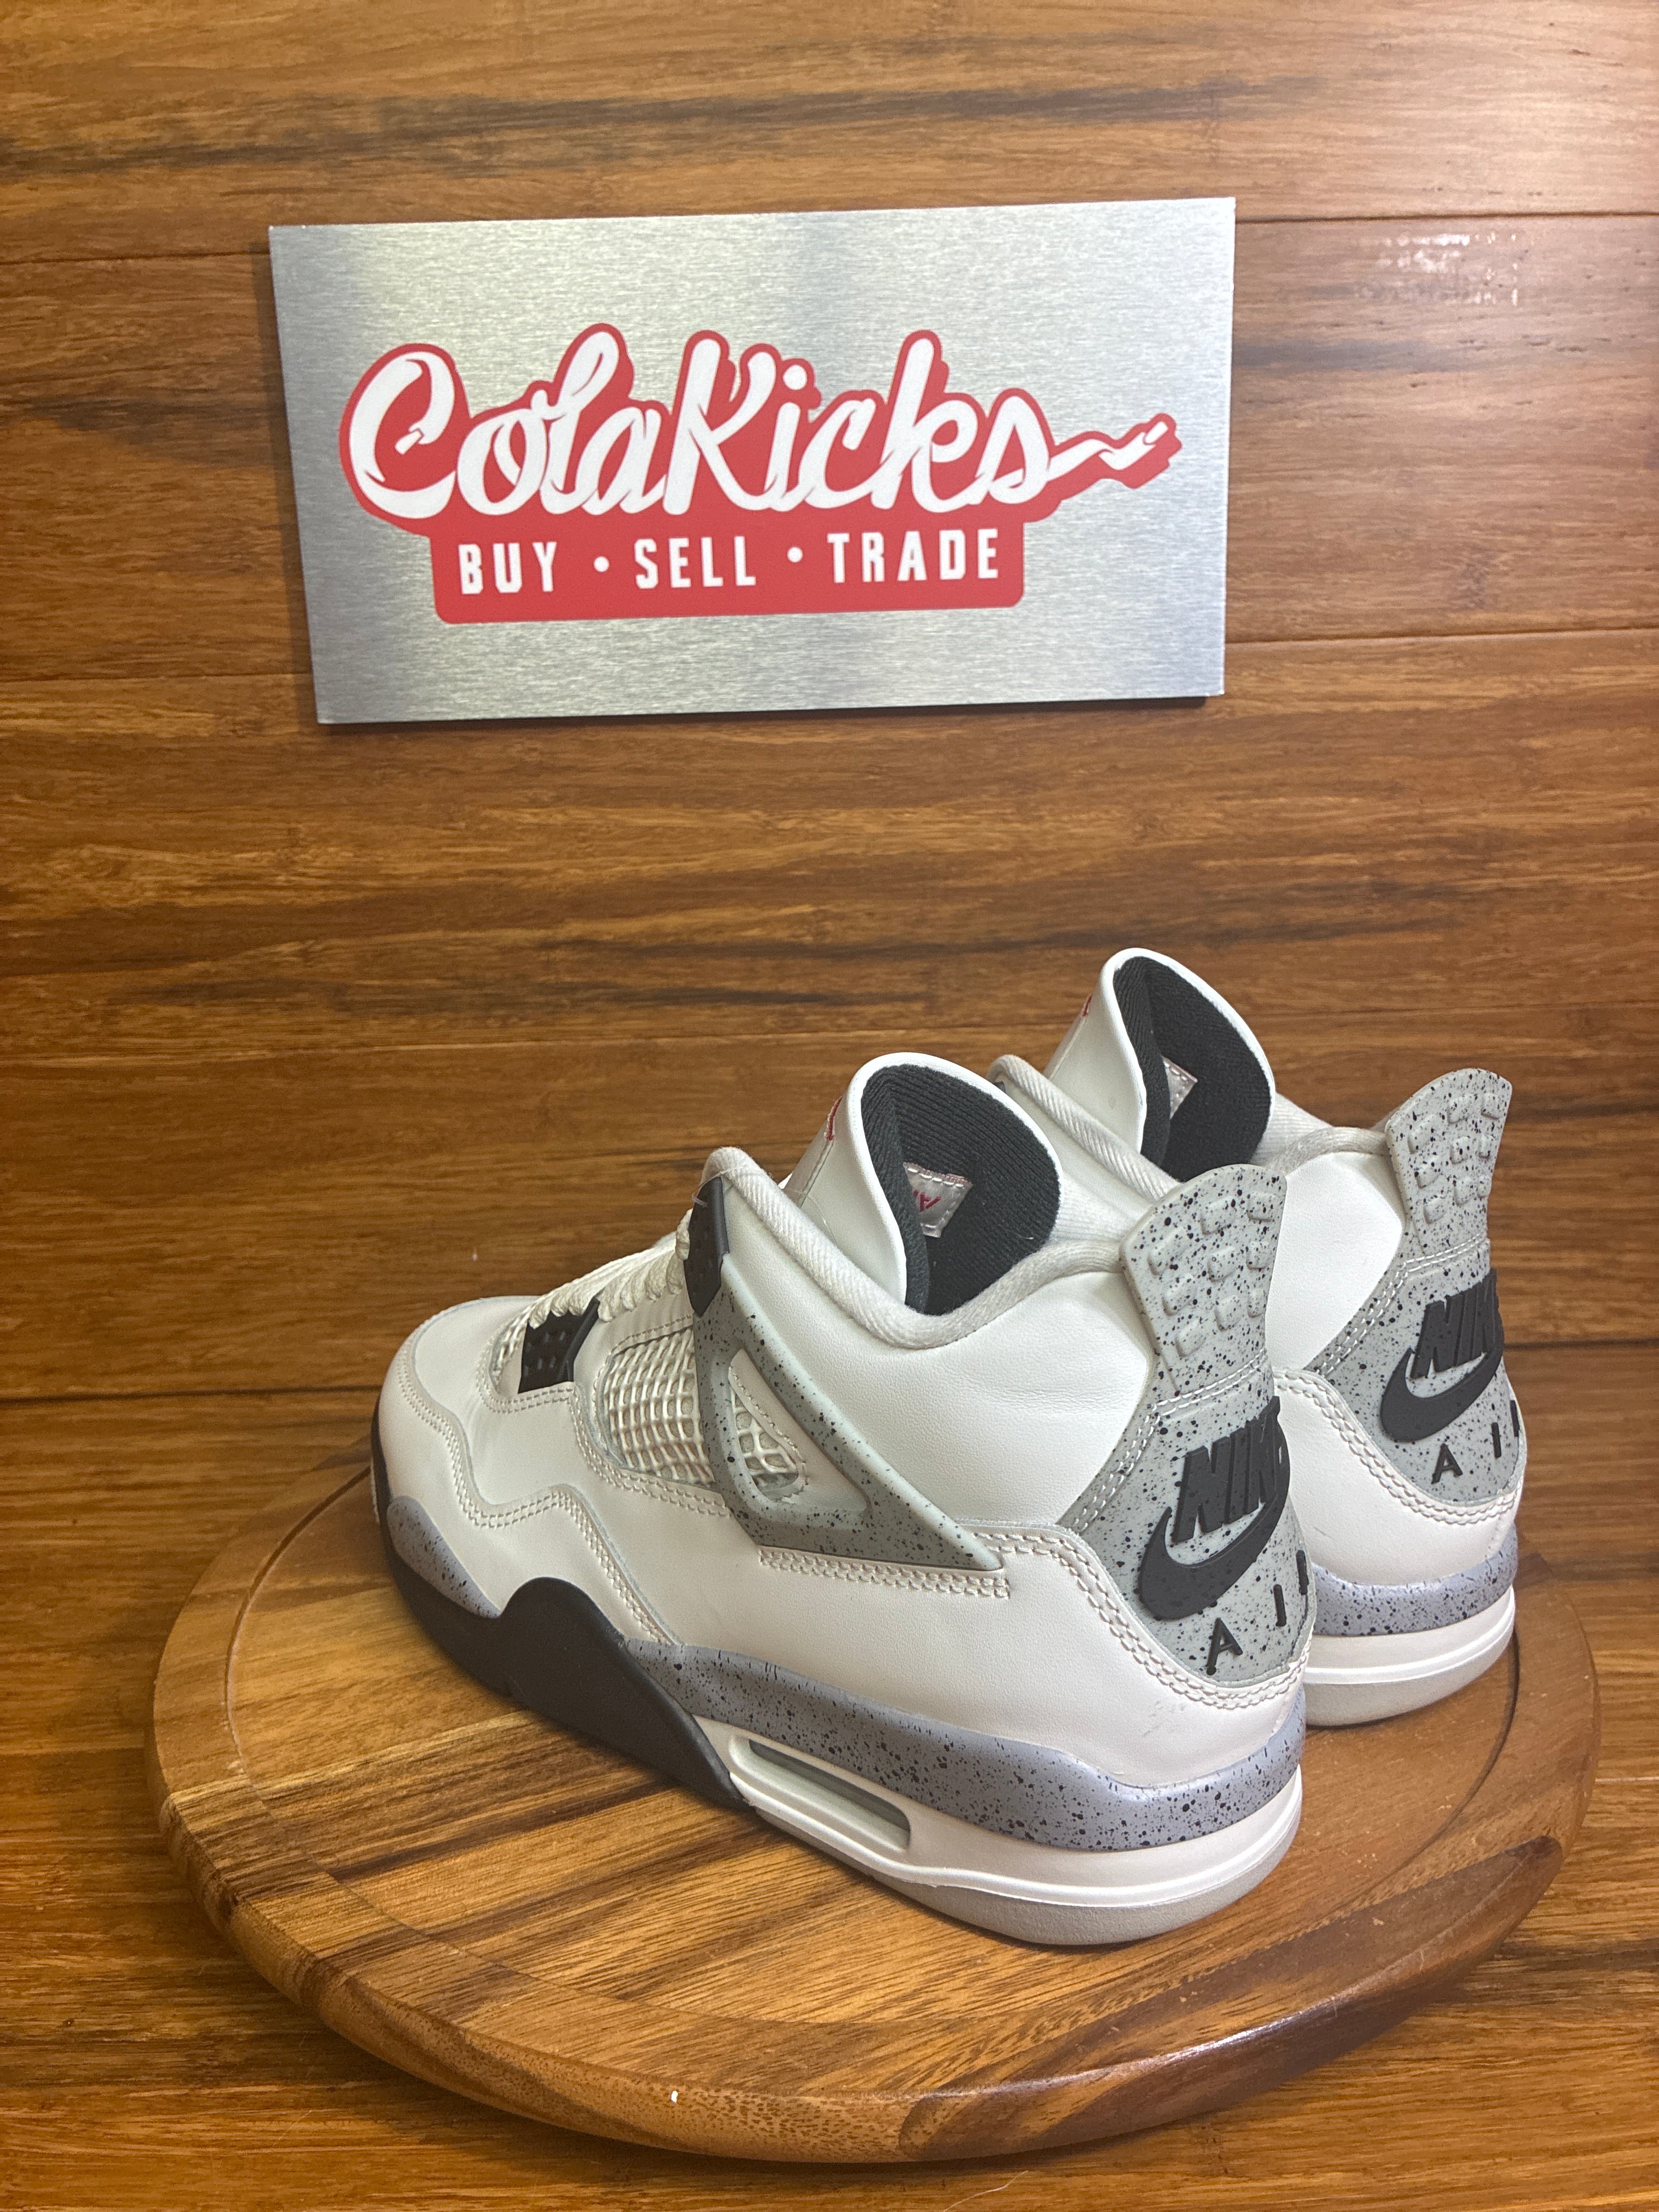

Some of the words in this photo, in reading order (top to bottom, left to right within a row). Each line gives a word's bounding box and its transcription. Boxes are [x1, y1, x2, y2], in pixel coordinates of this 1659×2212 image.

[349, 331, 1169, 519] ColaKicks
[458, 541, 557, 595] BUY
[634, 535, 757, 589] SELL
[827, 528, 998, 583] TRADE
[1410, 1268, 1499, 1379] NIK
[1172, 1395, 1282, 1544] NIK
